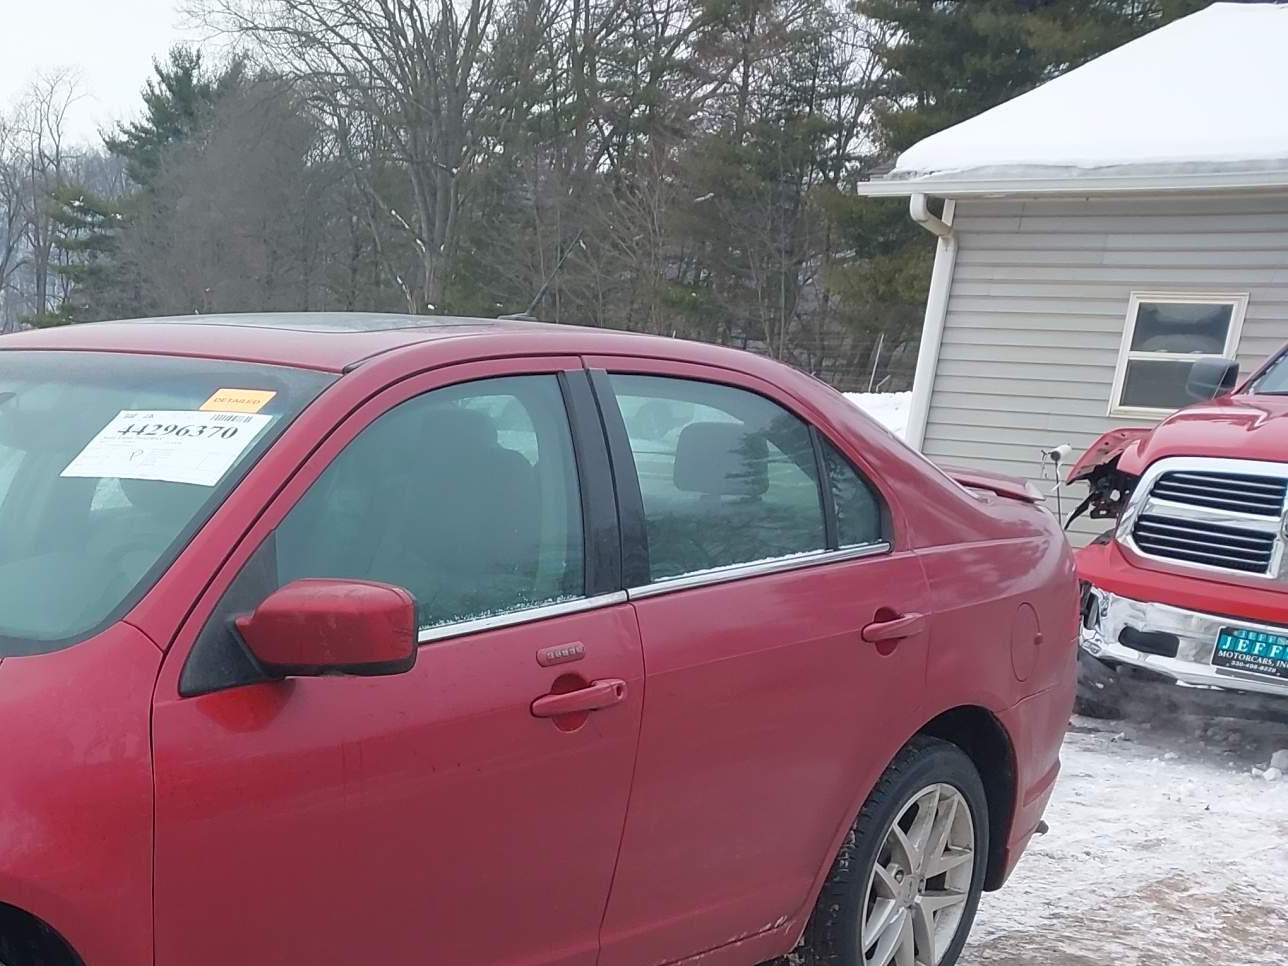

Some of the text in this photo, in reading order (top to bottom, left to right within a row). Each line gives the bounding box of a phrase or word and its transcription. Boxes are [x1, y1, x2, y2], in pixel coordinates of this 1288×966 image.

[116, 423, 239, 440] 44296370
[1222, 636, 1288, 659] JEFF
[1218, 650, 1275, 666] MOTORCARS,
